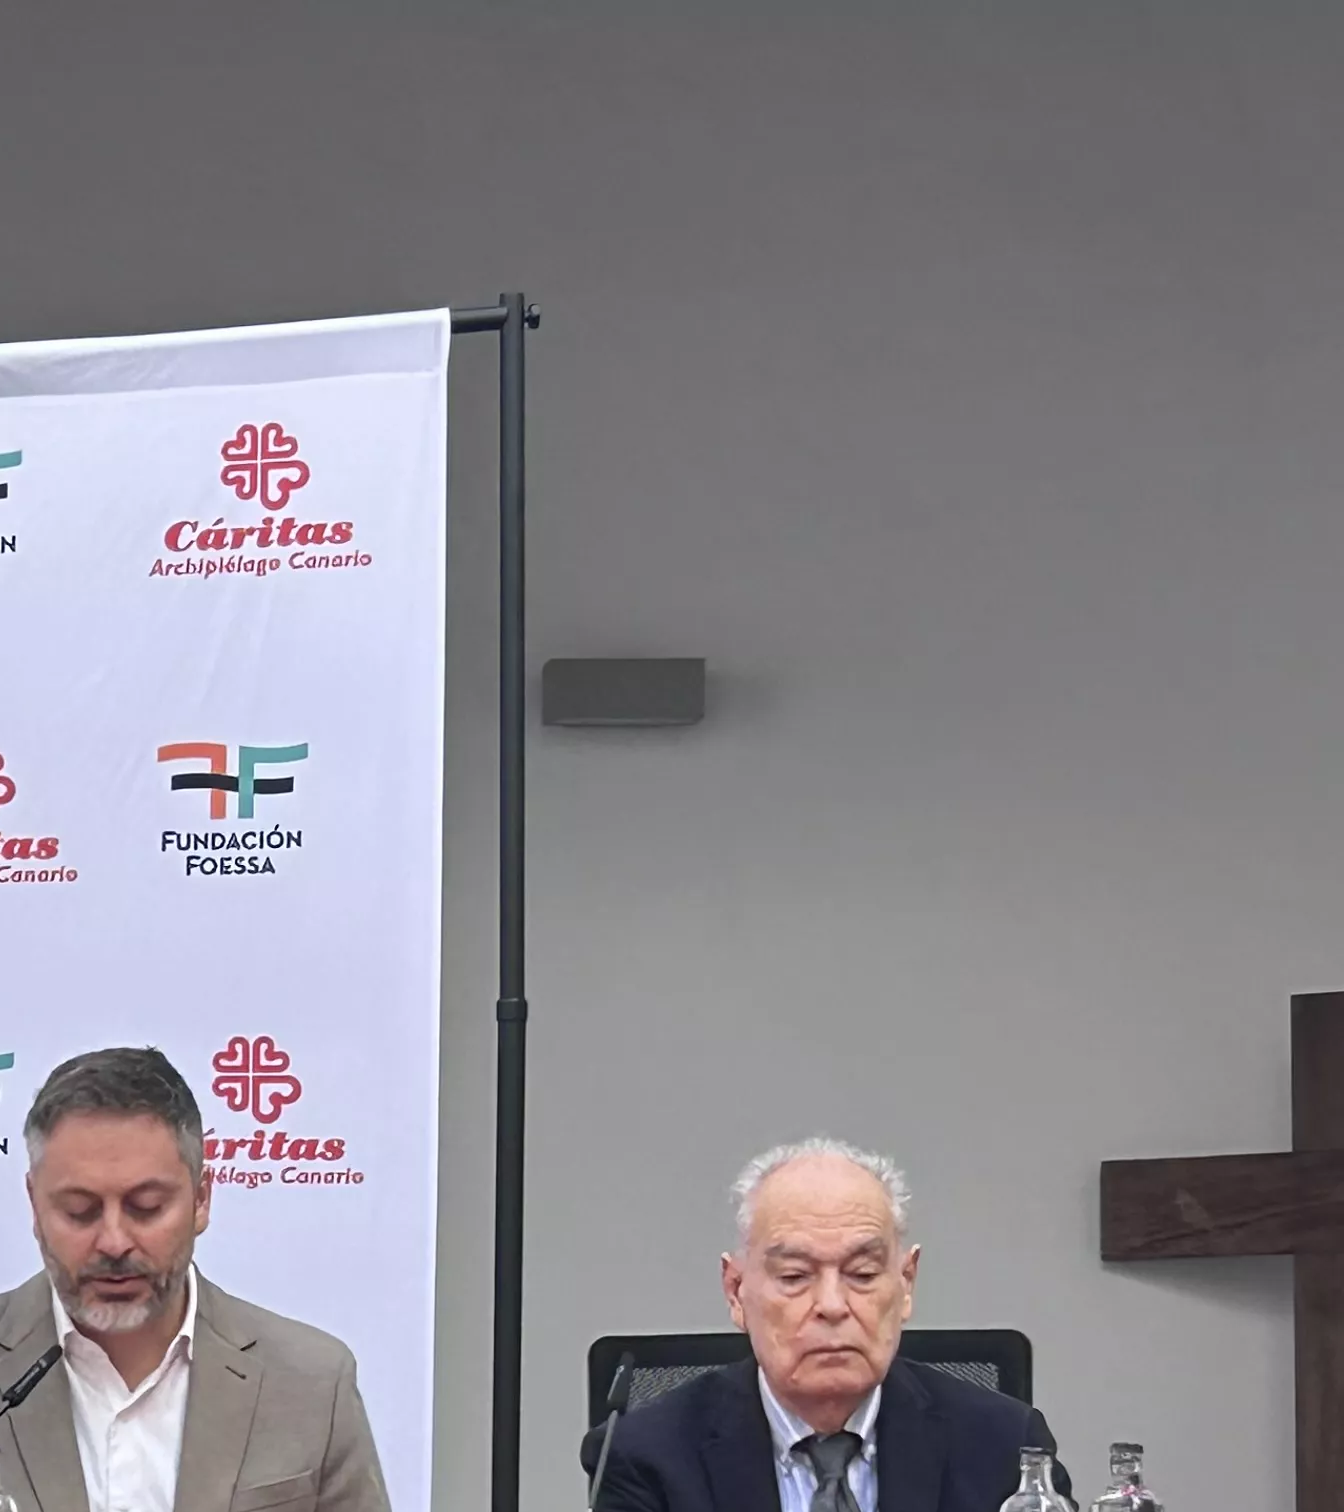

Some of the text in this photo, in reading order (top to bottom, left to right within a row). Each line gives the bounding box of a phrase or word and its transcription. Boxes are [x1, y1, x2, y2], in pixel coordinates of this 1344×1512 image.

[164, 517, 353, 552] Cáritas
[149, 550, 372, 580] Archipiélago Canario
[161, 824, 302, 852] FUNDACIÓN
[186, 855, 276, 876] FOESSA
[203, 1127, 346, 1161] áritas
[281, 1166, 364, 1184] Canario
